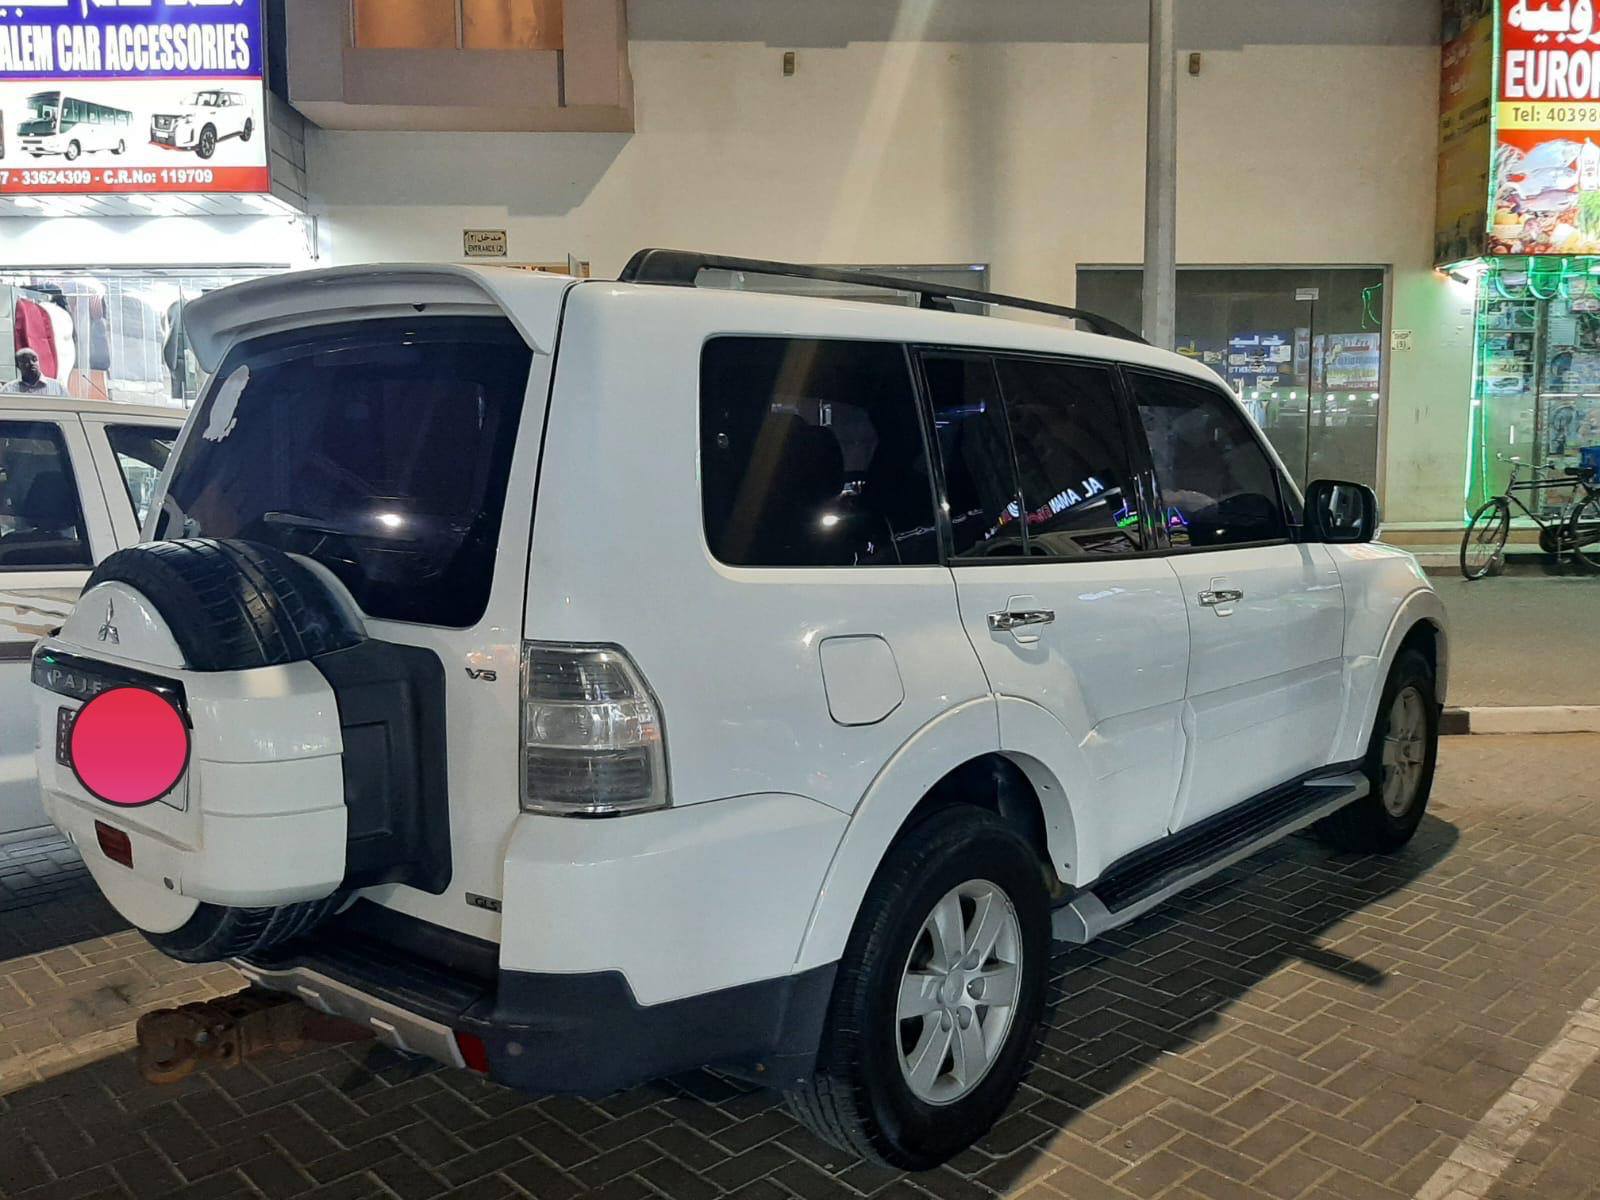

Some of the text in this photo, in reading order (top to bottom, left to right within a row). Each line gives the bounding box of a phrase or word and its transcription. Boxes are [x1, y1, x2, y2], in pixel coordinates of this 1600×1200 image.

[0, 23, 250, 71] ALEM CAR ACCESSORIES
[1513, 106, 1600, 122] Tel: 40398
[21, 170, 91, 185] 33624309
[103, 170, 156, 184] C.R.No:
[161, 169, 213, 183] 119709
[467, 244, 496, 252] ENTRANCE
[52, 669, 103, 694] PAJE
